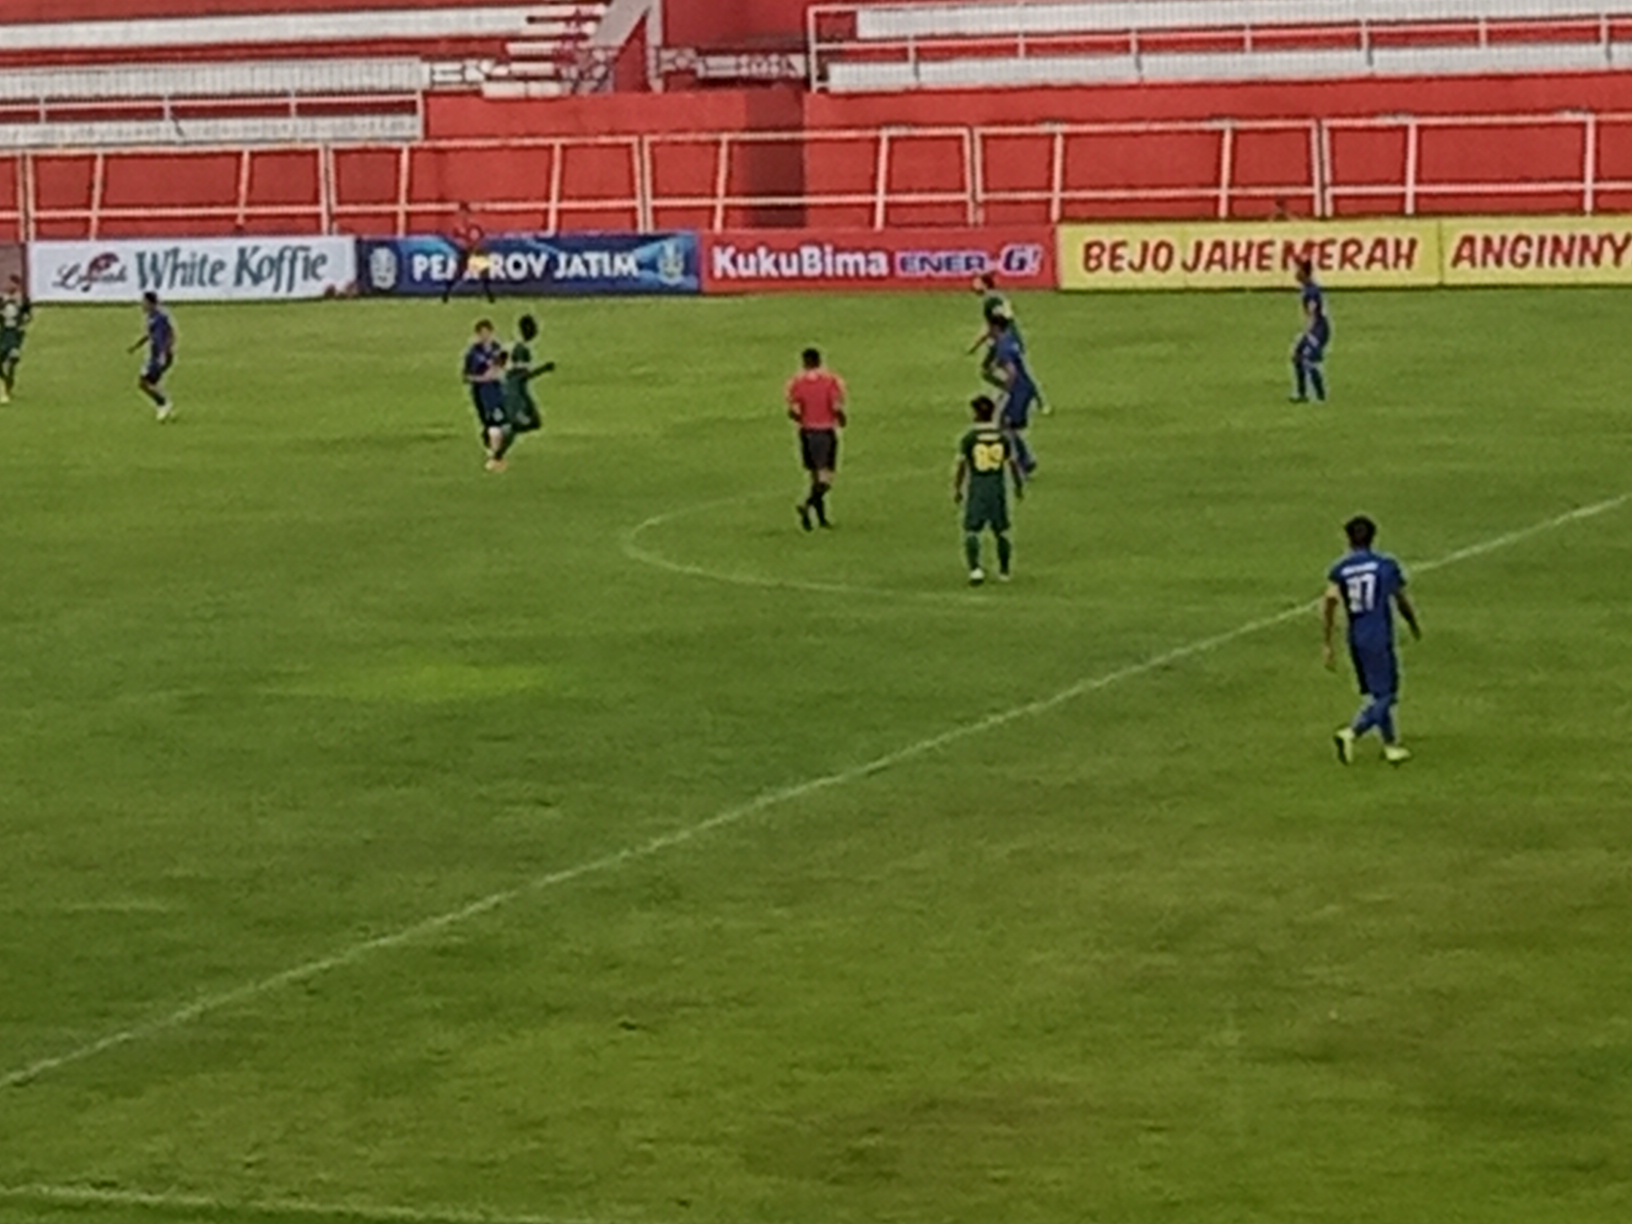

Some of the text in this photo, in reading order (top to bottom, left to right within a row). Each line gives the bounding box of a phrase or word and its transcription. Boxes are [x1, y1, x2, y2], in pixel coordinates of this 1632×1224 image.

[135, 246, 228, 290] White
[233, 245, 328, 294] Koffie
[412, 249, 640, 281] PEROV JATIM
[712, 243, 890, 278] KukuBima
[1082, 237, 1418, 273] BEJO JAHE MERAH
